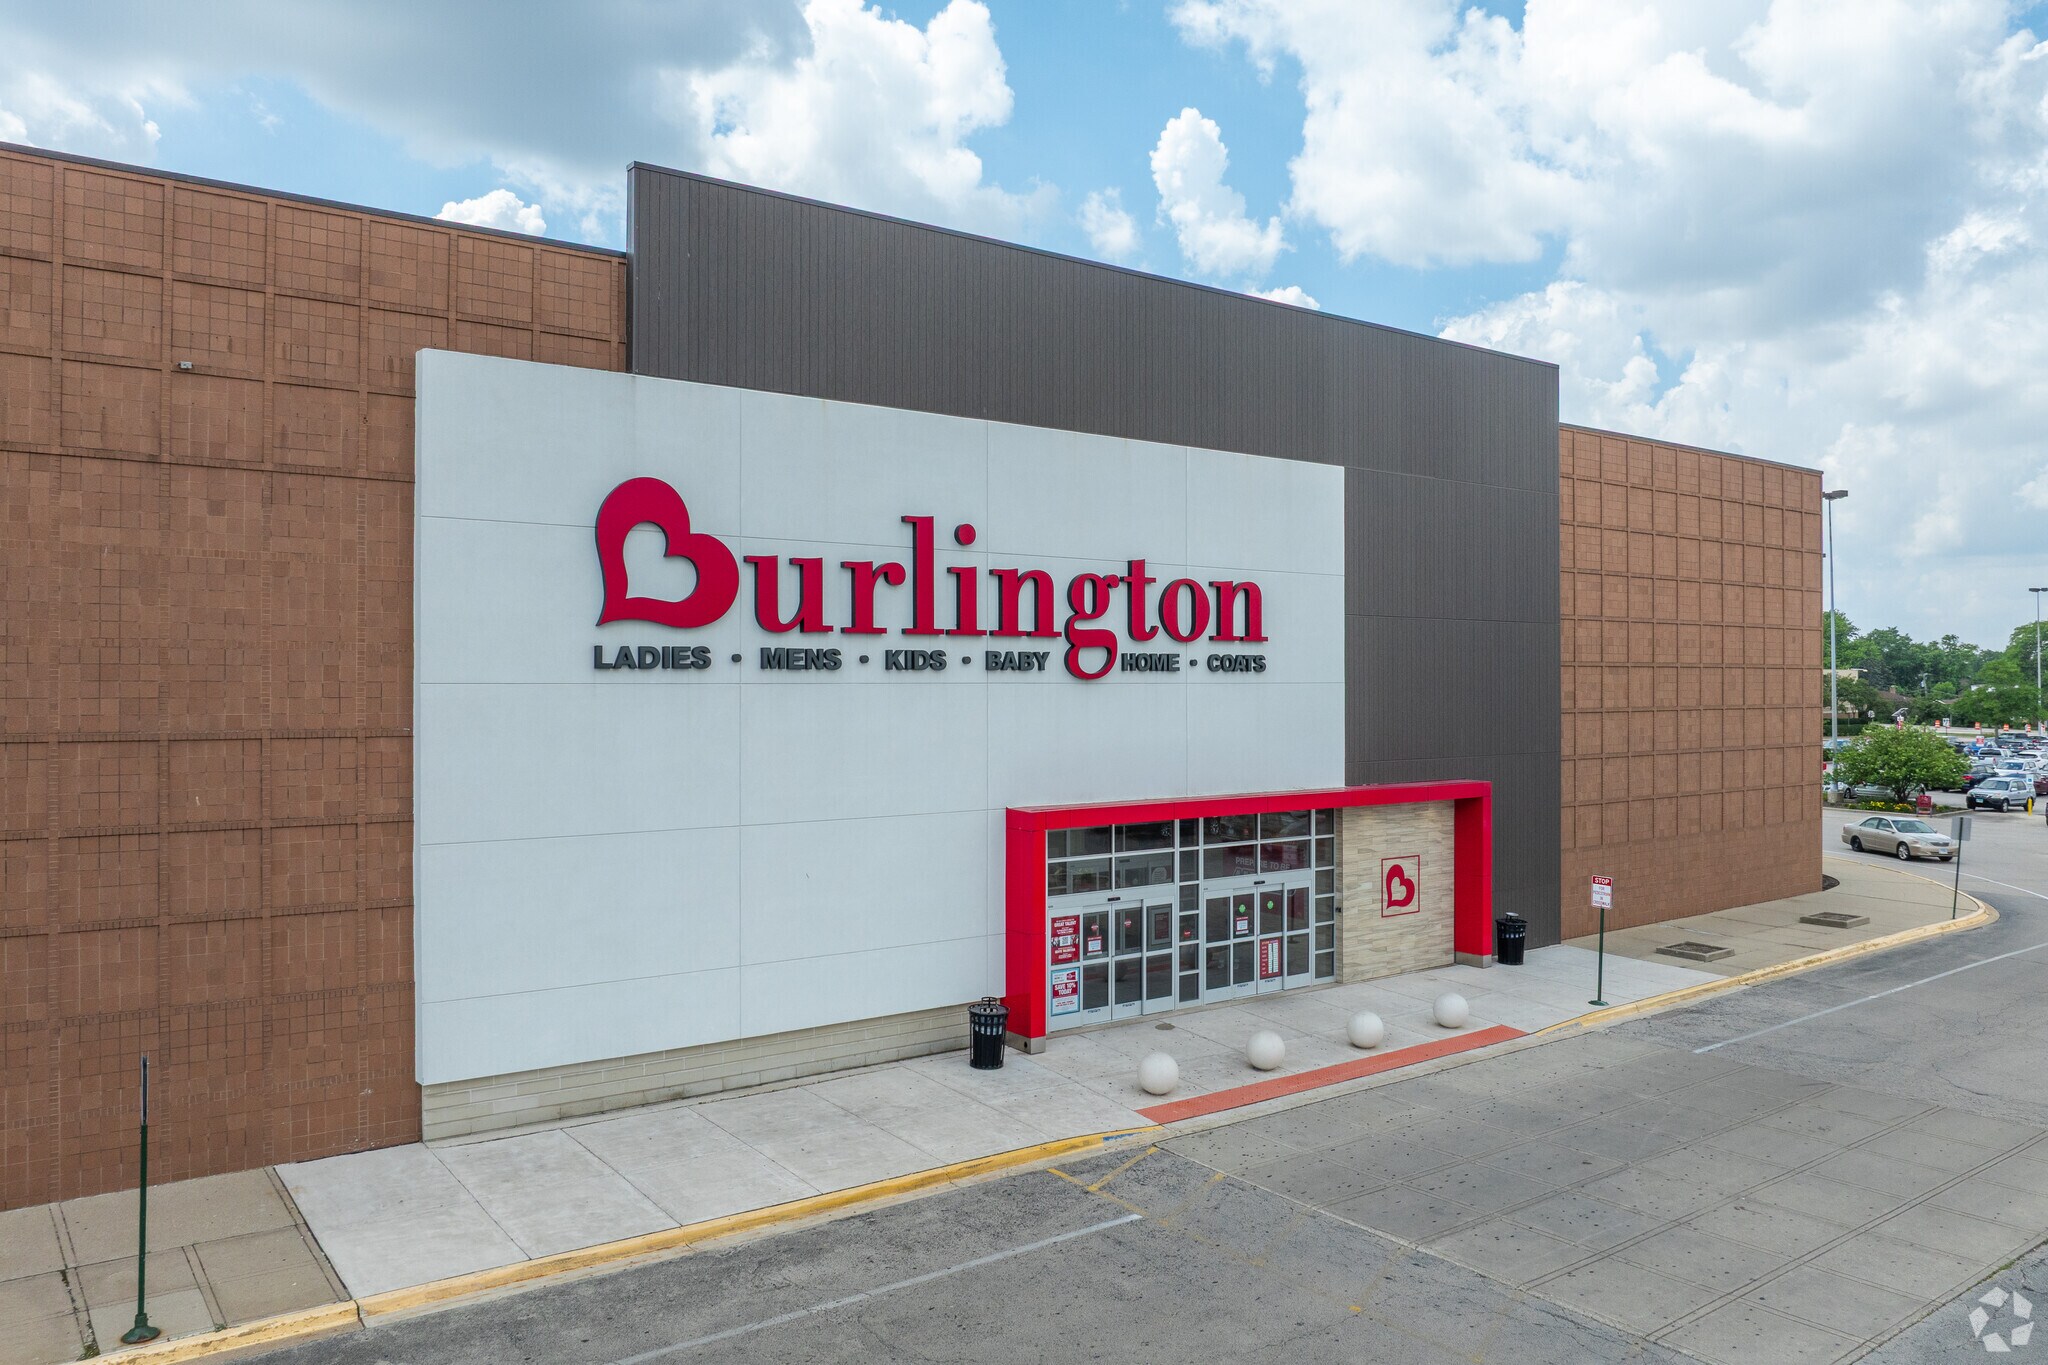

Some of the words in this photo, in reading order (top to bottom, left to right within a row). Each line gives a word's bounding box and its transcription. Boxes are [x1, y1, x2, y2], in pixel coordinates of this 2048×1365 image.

[595, 477, 1268, 679] Burlington
[593, 645, 712, 670] LADIES
[760, 647, 842, 671] MENS
[885, 649, 948, 671] KIDS
[985, 650, 1050, 672] BABY
[1121, 652, 1180, 672] HOME
[1207, 653, 1267, 673] COATS
[1235, 856, 1268, 869] PREPRE
[1270, 861, 1279, 870] TO
